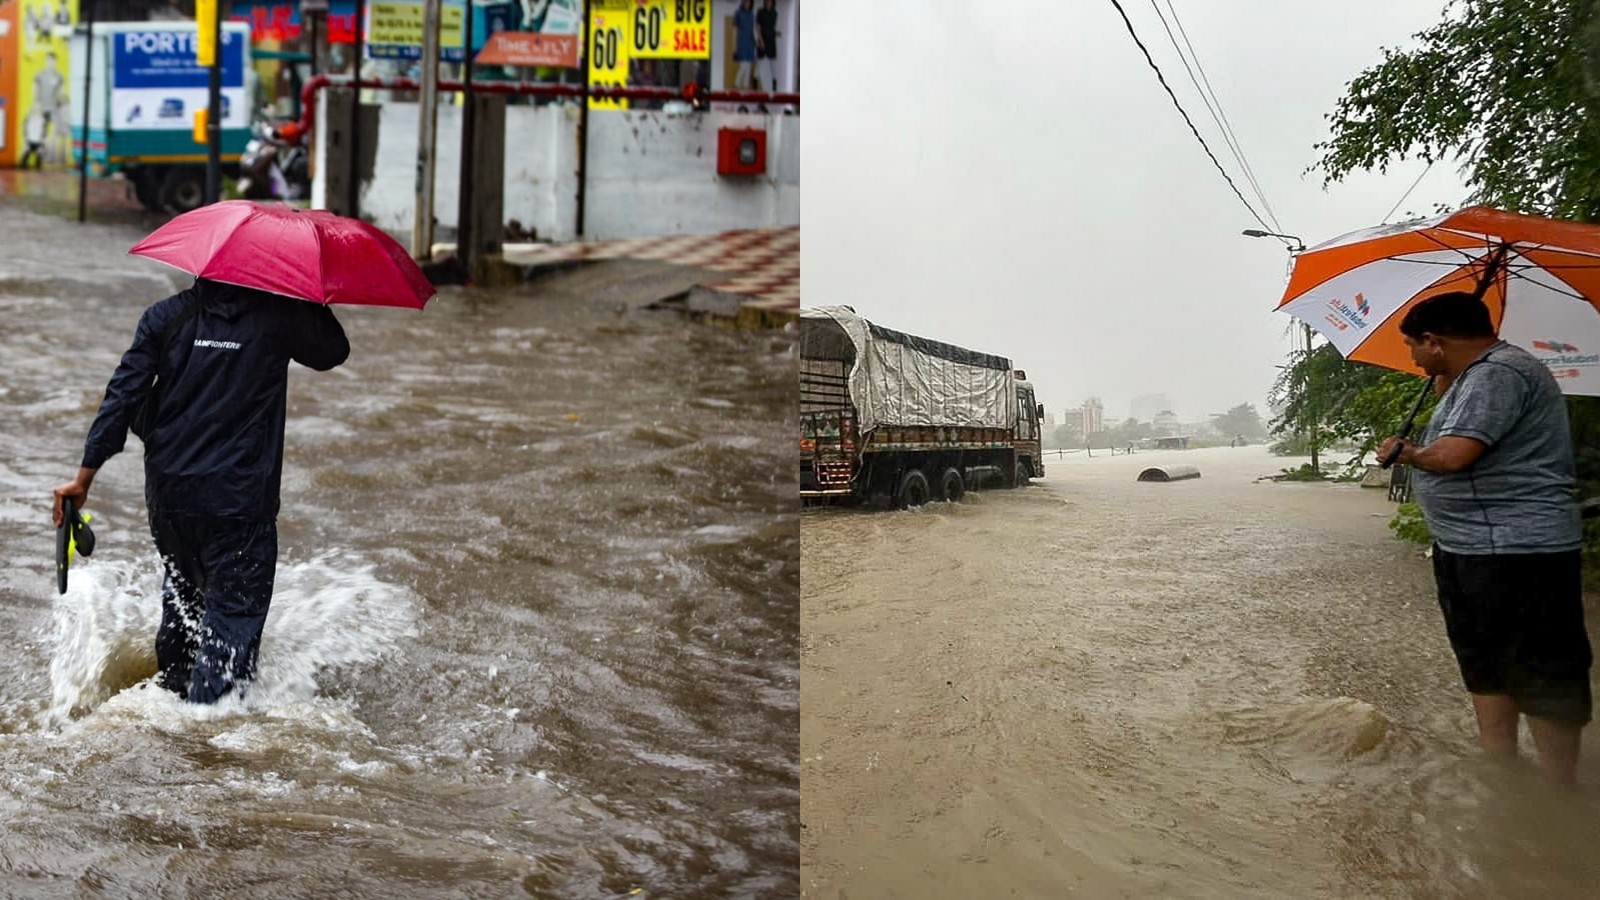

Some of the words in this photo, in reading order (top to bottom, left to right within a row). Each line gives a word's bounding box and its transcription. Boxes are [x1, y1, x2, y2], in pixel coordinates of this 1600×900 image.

[675, 0, 705, 22] BIG
[124, 32, 204, 54] PORTE
[673, 29, 706, 52] SALE
